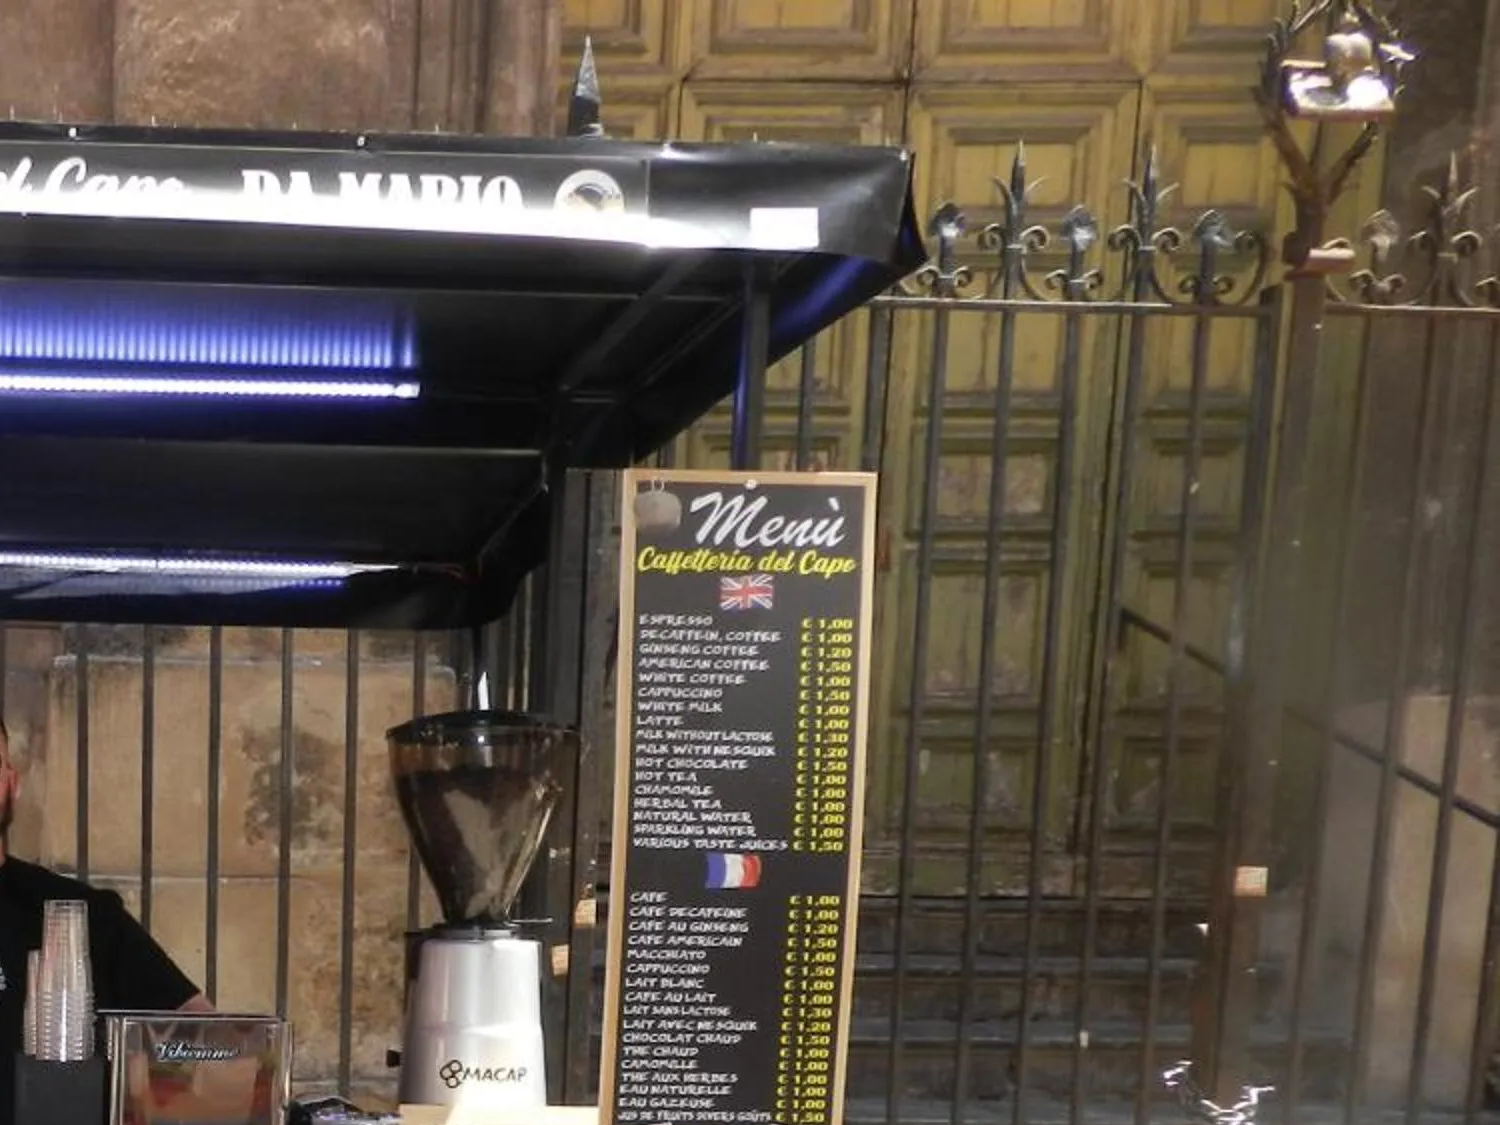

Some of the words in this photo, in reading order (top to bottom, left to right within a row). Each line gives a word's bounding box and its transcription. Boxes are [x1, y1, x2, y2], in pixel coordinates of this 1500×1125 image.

[338, 172, 523, 210] MARIO
[690, 491, 846, 548] Menù
[638, 546, 752, 574] Caffetteria
[758, 551, 793, 573] del
[800, 550, 856, 579] Capo
[639, 614, 713, 625] ESPRESSO
[726, 630, 781, 642] COFFEE
[703, 645, 759, 656] COFFEE
[639, 659, 711, 670] AMERICAN
[713, 660, 770, 671] COFFEE
[639, 672, 685, 683] WHITE
[690, 673, 746, 684] COFFEE
[638, 687, 723, 698] CAPPUCCINO
[638, 701, 685, 712] WHITE
[636, 715, 684, 726] LATTE
[636, 758, 663, 769] HOT
[667, 758, 748, 770] CHOCOLATE
[635, 771, 663, 782] HOT
[668, 771, 697, 783] TEA
[634, 797, 688, 809] HERBAL
[692, 798, 722, 809] TEA
[633, 811, 697, 822] NATURAL
[700, 811, 752, 824] WATER
[634, 824, 704, 836] SPARKLING
[707, 825, 756, 837] WATER
[633, 838, 689, 849] VARIOUS
[694, 838, 735, 849] TASTE
[668, 921, 686, 932] AU
[665, 992, 683, 1003] AU
[623, 1034, 693, 1044] CHOCOLAT
[463, 1066, 527, 1083] MACAP
